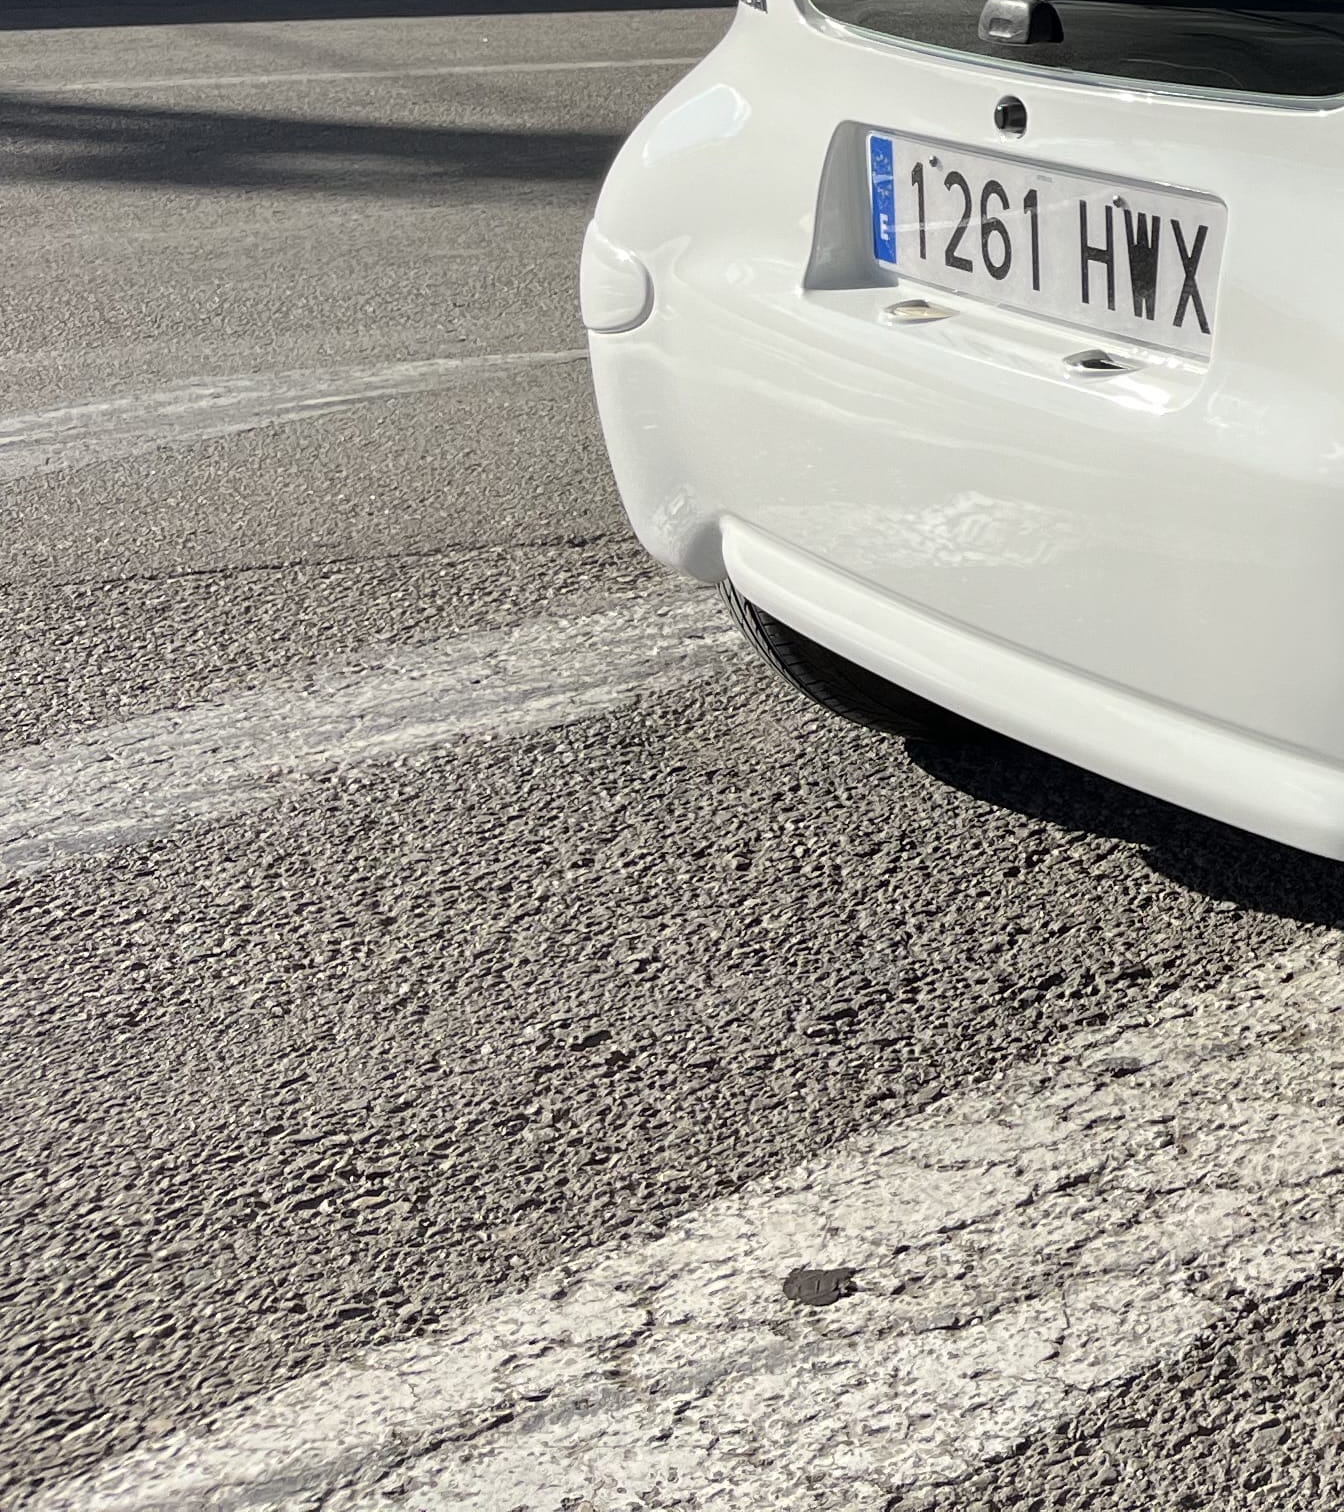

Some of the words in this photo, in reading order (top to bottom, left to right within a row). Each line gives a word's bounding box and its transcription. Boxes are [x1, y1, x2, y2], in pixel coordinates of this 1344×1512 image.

[879, 213, 890, 241] E
[911, 161, 1041, 291] 1261
[1079, 199, 1212, 335] HWX
